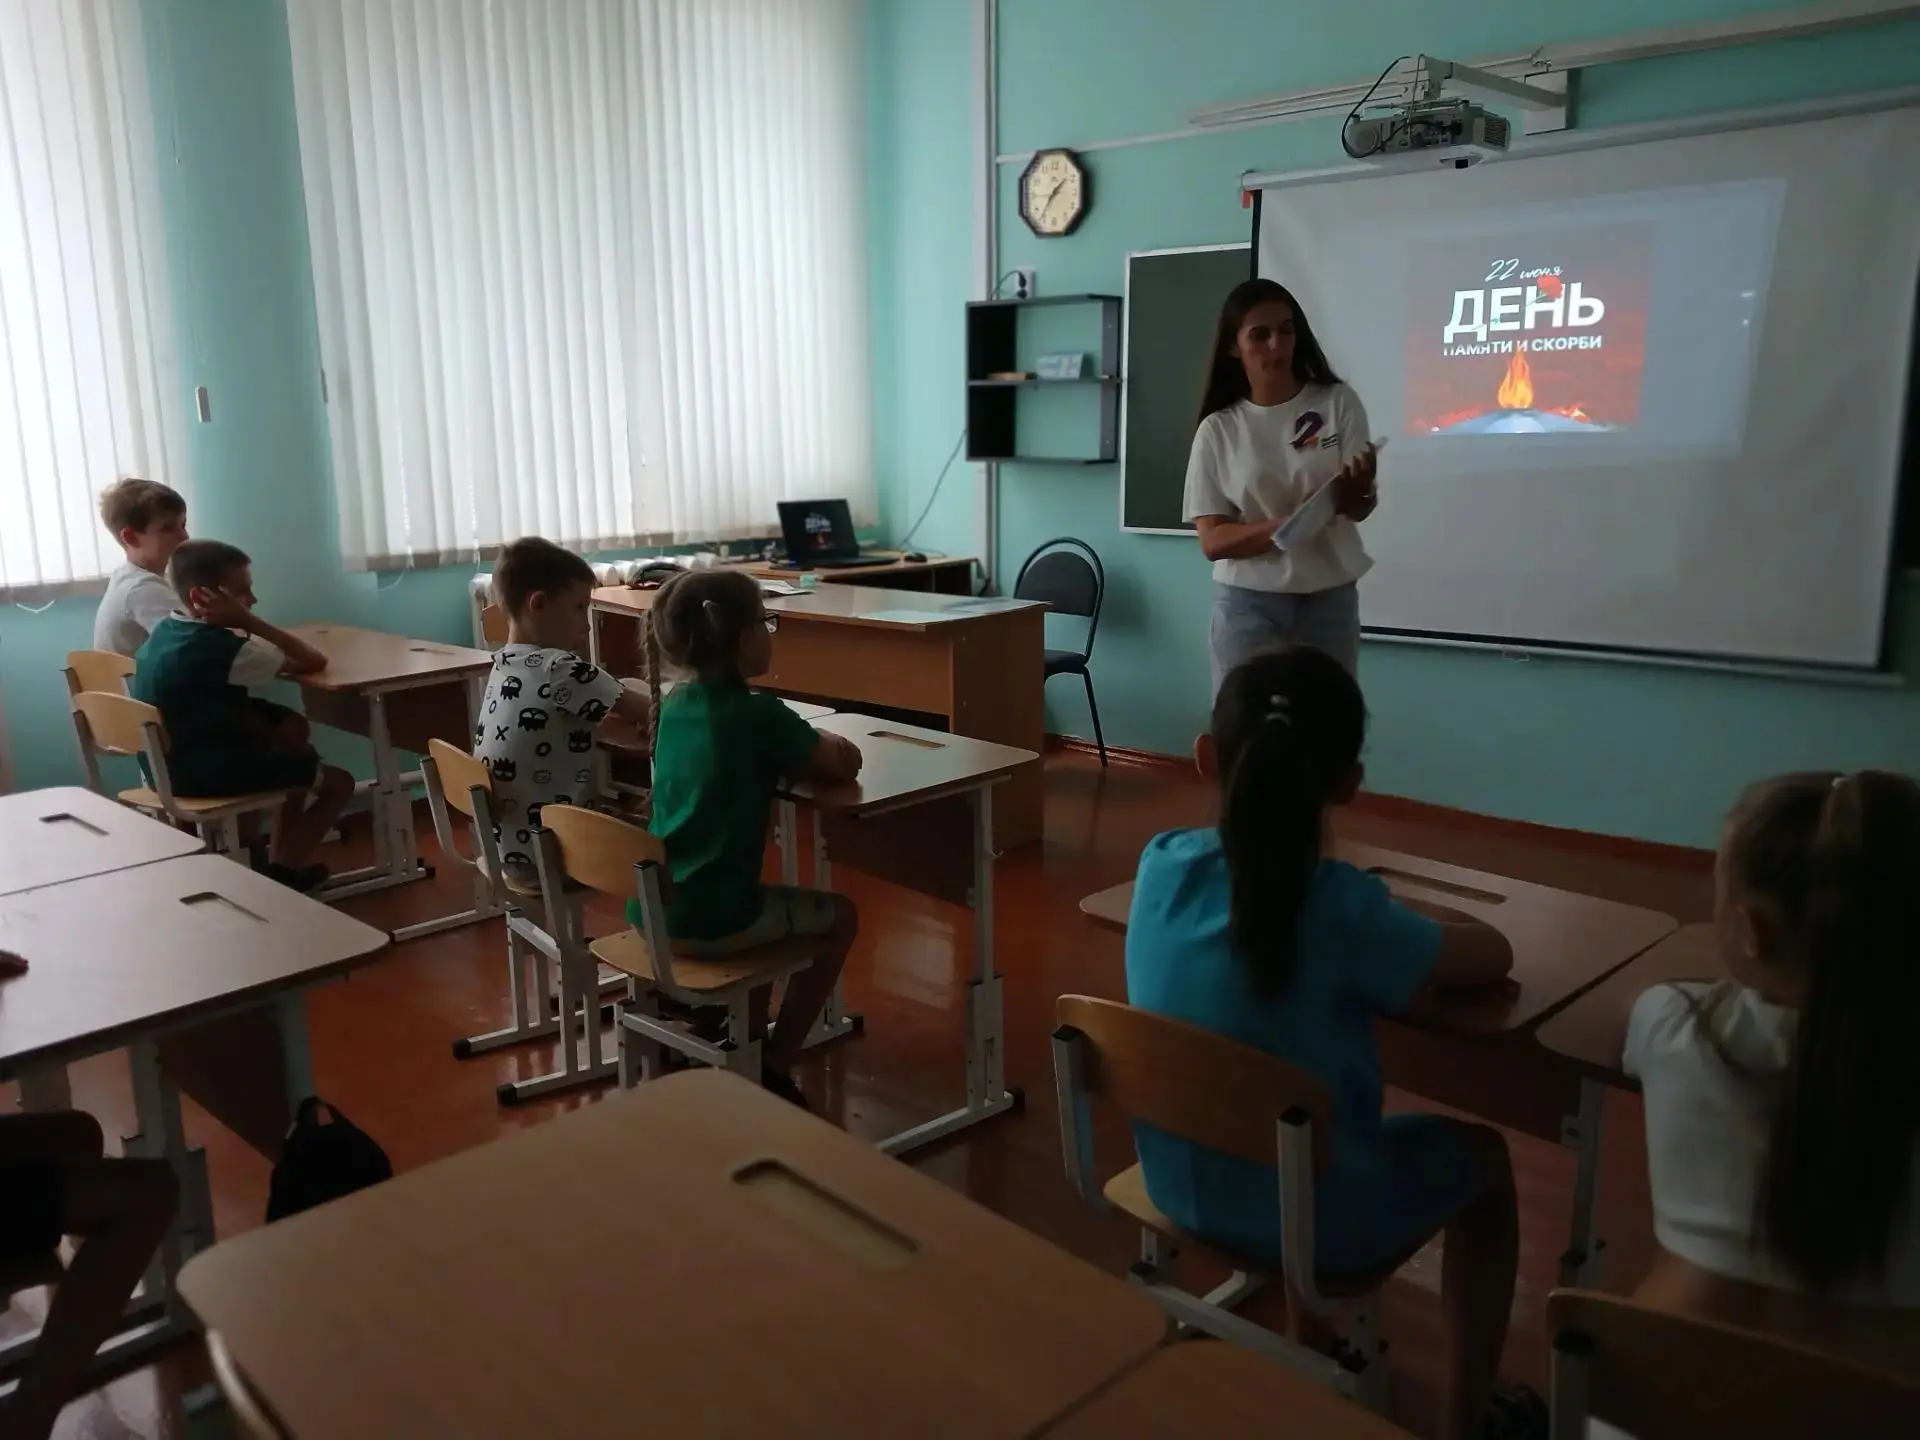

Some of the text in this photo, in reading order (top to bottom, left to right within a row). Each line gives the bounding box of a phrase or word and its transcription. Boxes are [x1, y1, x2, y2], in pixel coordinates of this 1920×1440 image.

[1485, 258, 1519, 282] 22
[1443, 282, 1605, 344] ДЕНЬ
[1531, 335, 1603, 352] СКОРБИ
